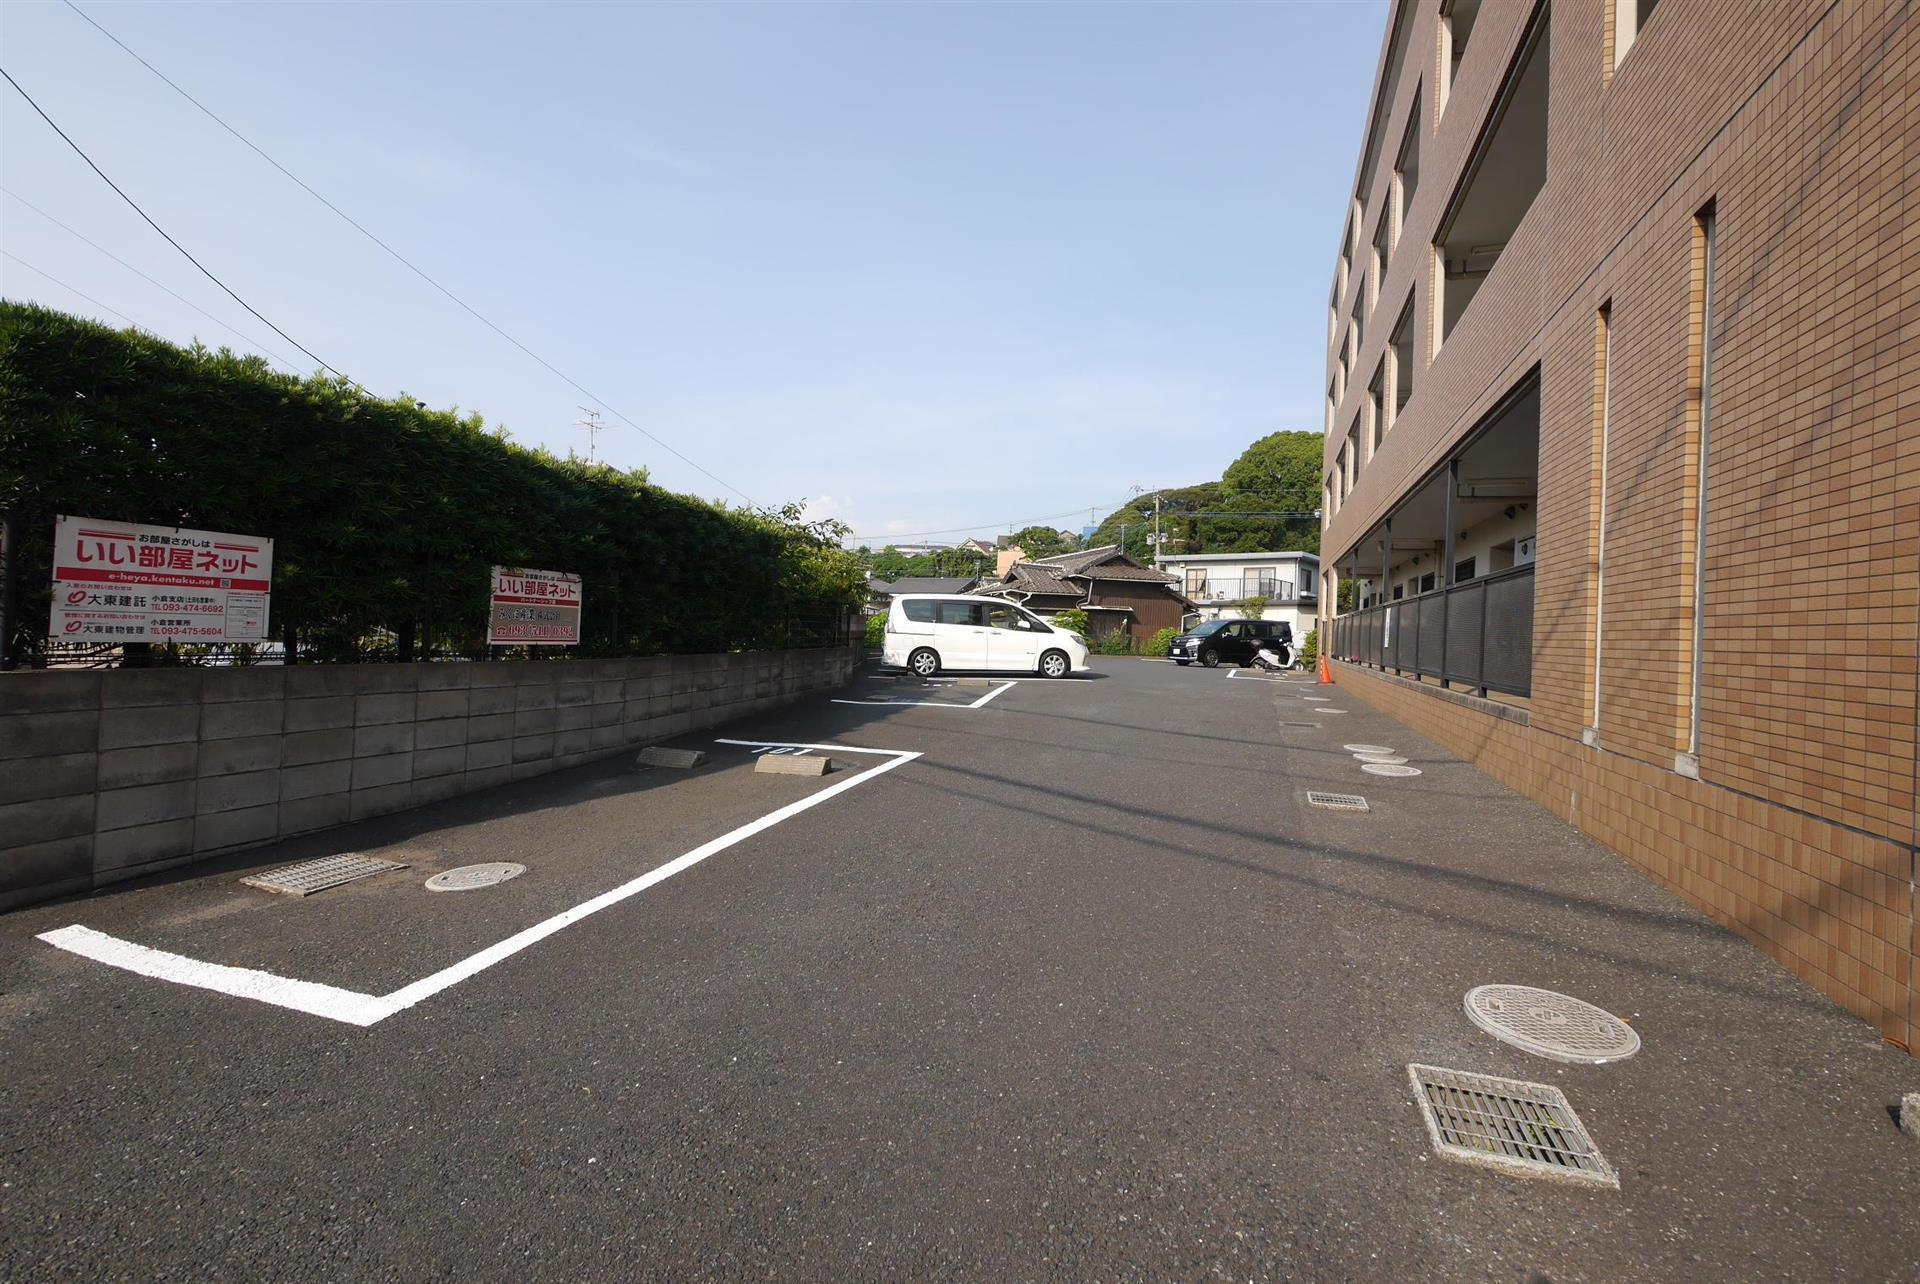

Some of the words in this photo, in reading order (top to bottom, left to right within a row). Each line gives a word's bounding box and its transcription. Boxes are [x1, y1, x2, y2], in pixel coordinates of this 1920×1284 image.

[138, 534, 211, 548] お部屋さがしは
[76, 539, 259, 575] いい部屋ネット
[108, 573, 215, 587] e-heya.kentaku.net
[499, 578, 576, 599] いい部屋ネット
[87, 593, 147, 608] 大東建託
[83, 624, 145, 635] 大東建物管理
[150, 619, 192, 627] 小倉営業所
[161, 627, 223, 636] 093-475-5604
